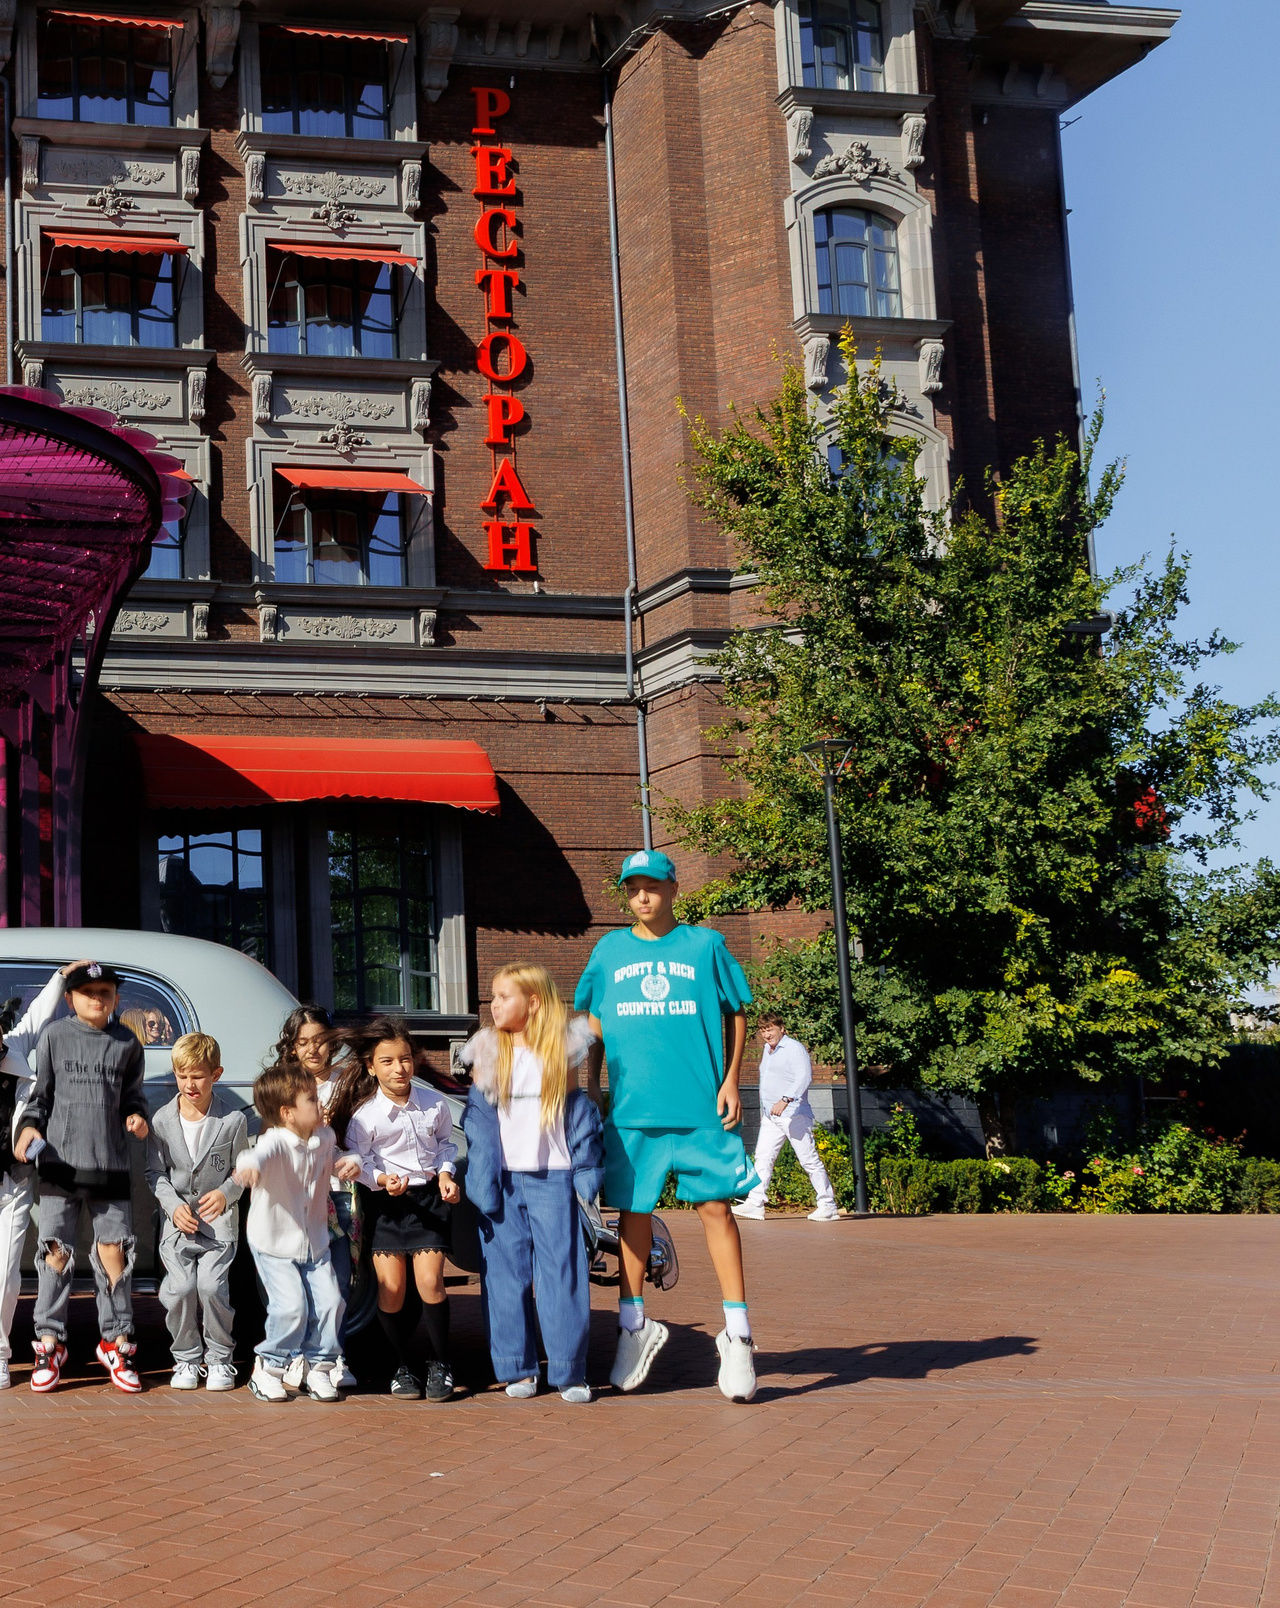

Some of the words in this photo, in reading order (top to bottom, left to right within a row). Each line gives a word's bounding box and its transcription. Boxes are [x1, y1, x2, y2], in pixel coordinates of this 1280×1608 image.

[471, 87, 538, 573] РЕСТОРАН
[614, 961, 653, 984] SPORTY
[657, 961, 666, 975] &
[668, 961, 696, 981] RICH
[616, 1001, 666, 1017] COUNTRY
[668, 1000, 697, 1015] CLUB
